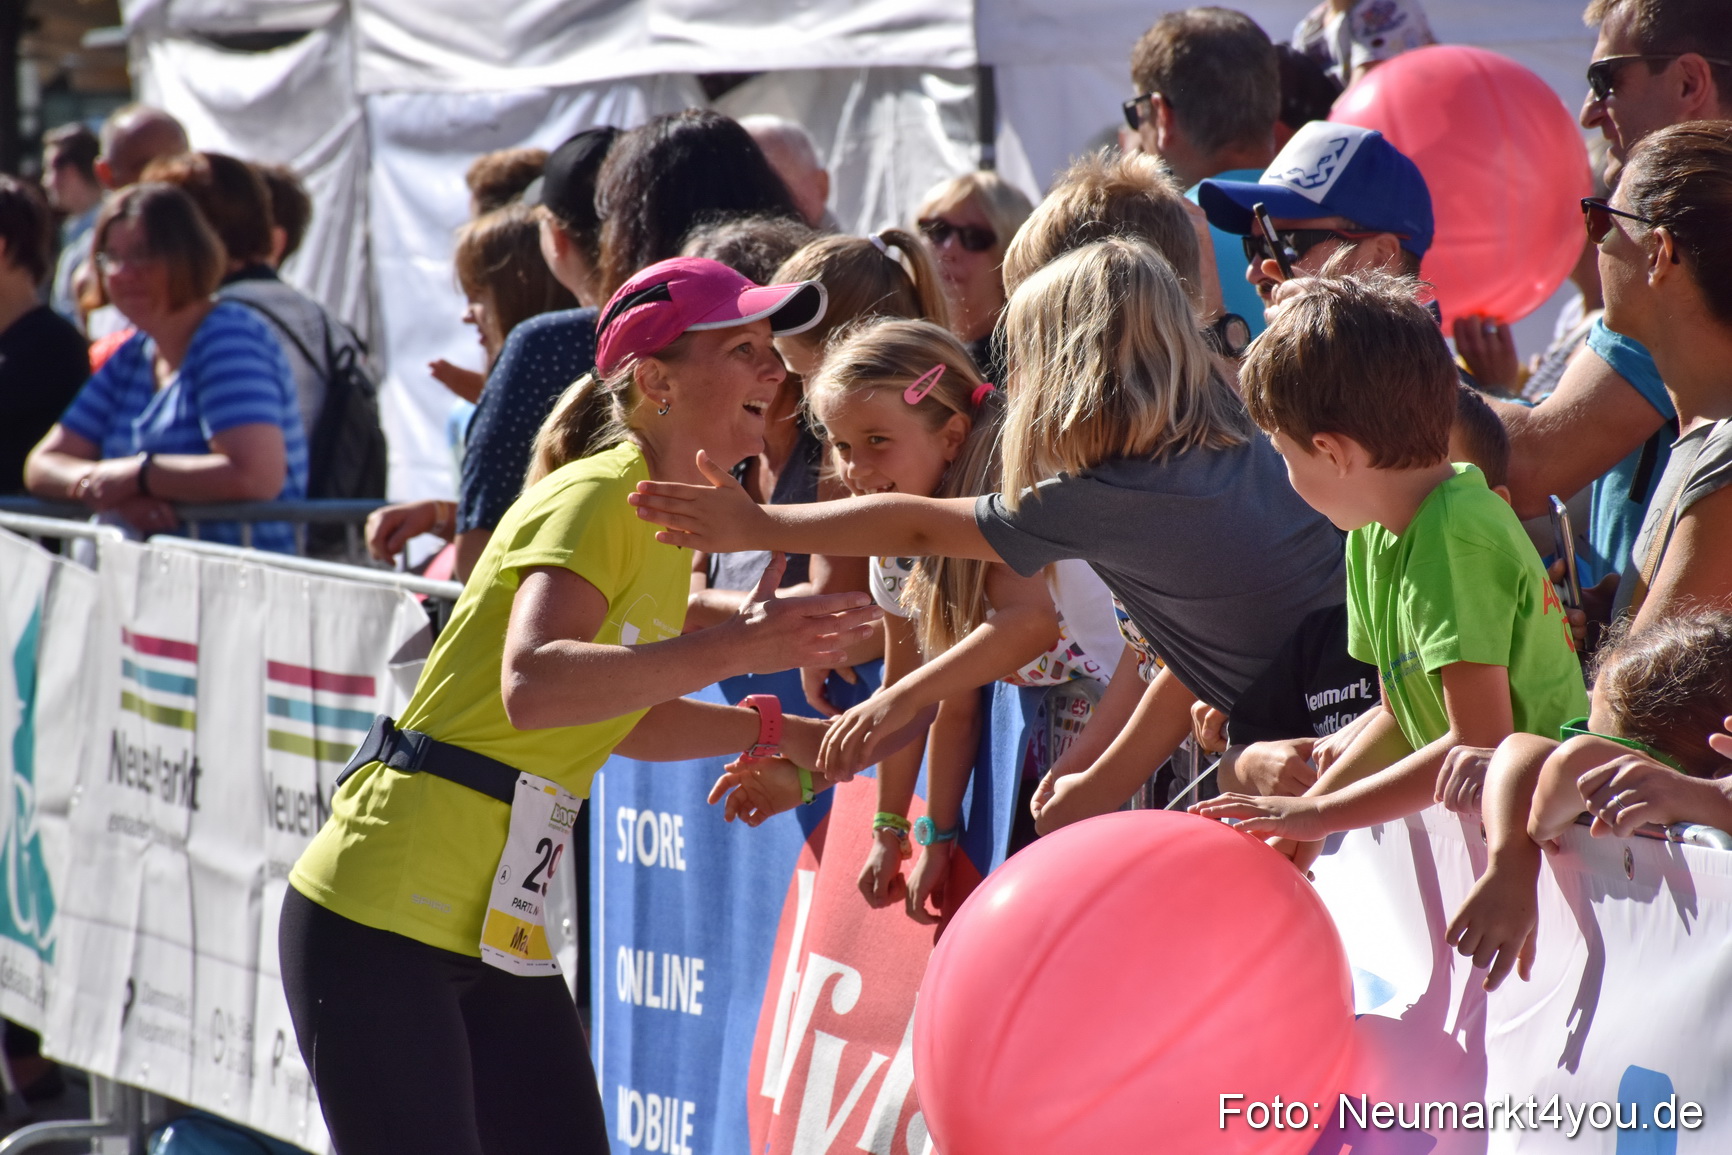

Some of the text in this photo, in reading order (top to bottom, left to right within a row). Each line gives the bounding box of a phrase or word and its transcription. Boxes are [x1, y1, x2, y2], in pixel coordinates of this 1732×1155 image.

[616, 805, 687, 872] STORE
[616, 945, 705, 1016] ONLINE
[616, 1084, 696, 1155] MOBILE
